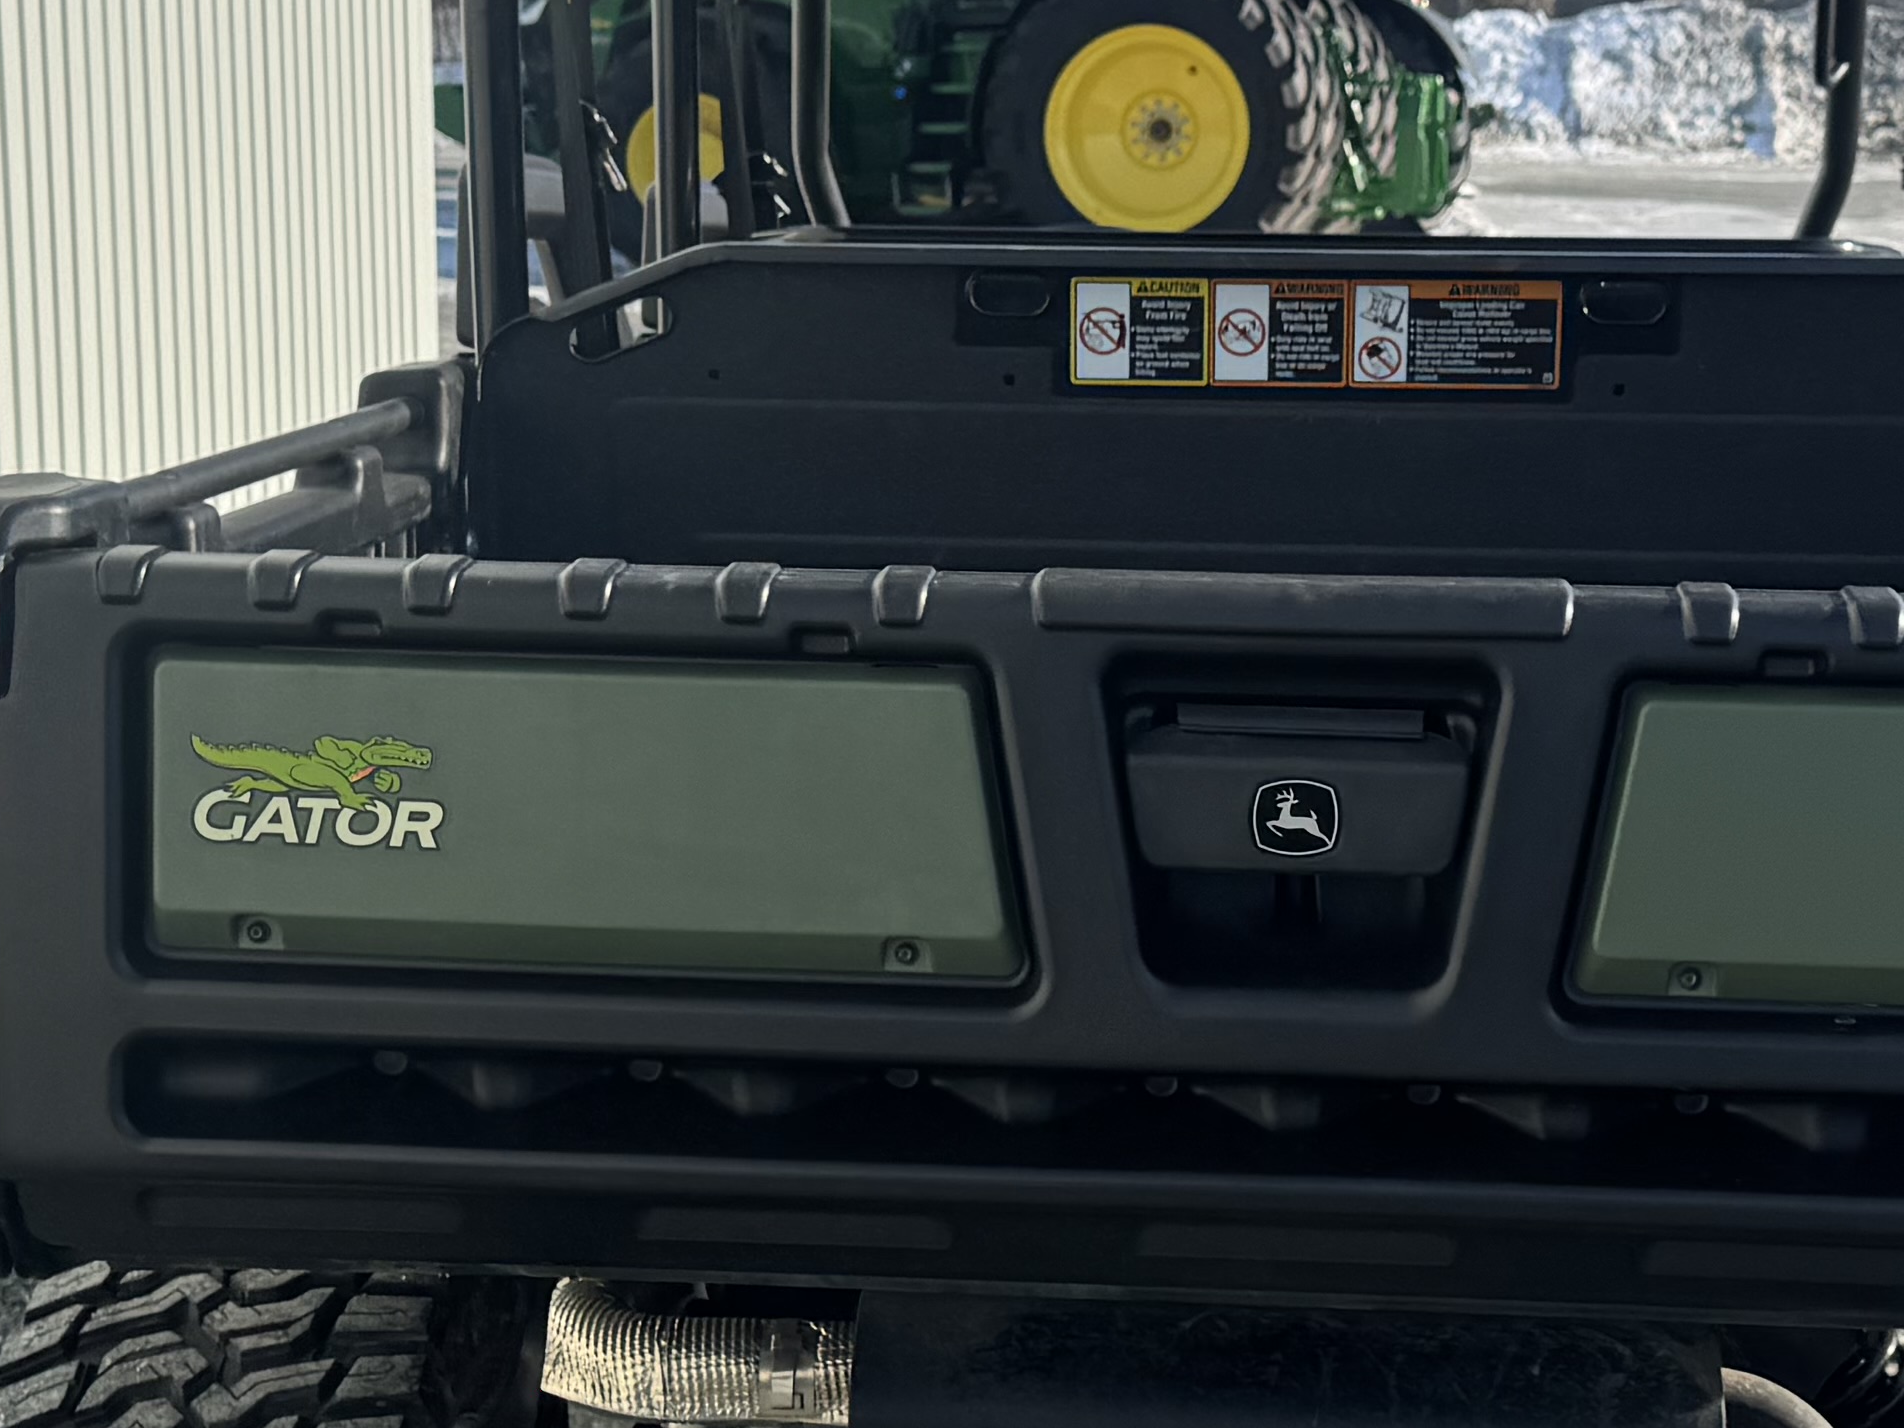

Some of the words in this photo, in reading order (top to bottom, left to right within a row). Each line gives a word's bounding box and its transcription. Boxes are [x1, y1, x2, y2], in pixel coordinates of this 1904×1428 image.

[1150, 281, 1200, 293] CAUTION
[1462, 284, 1520, 296] WARNING
[193, 788, 444, 849] GATOR
